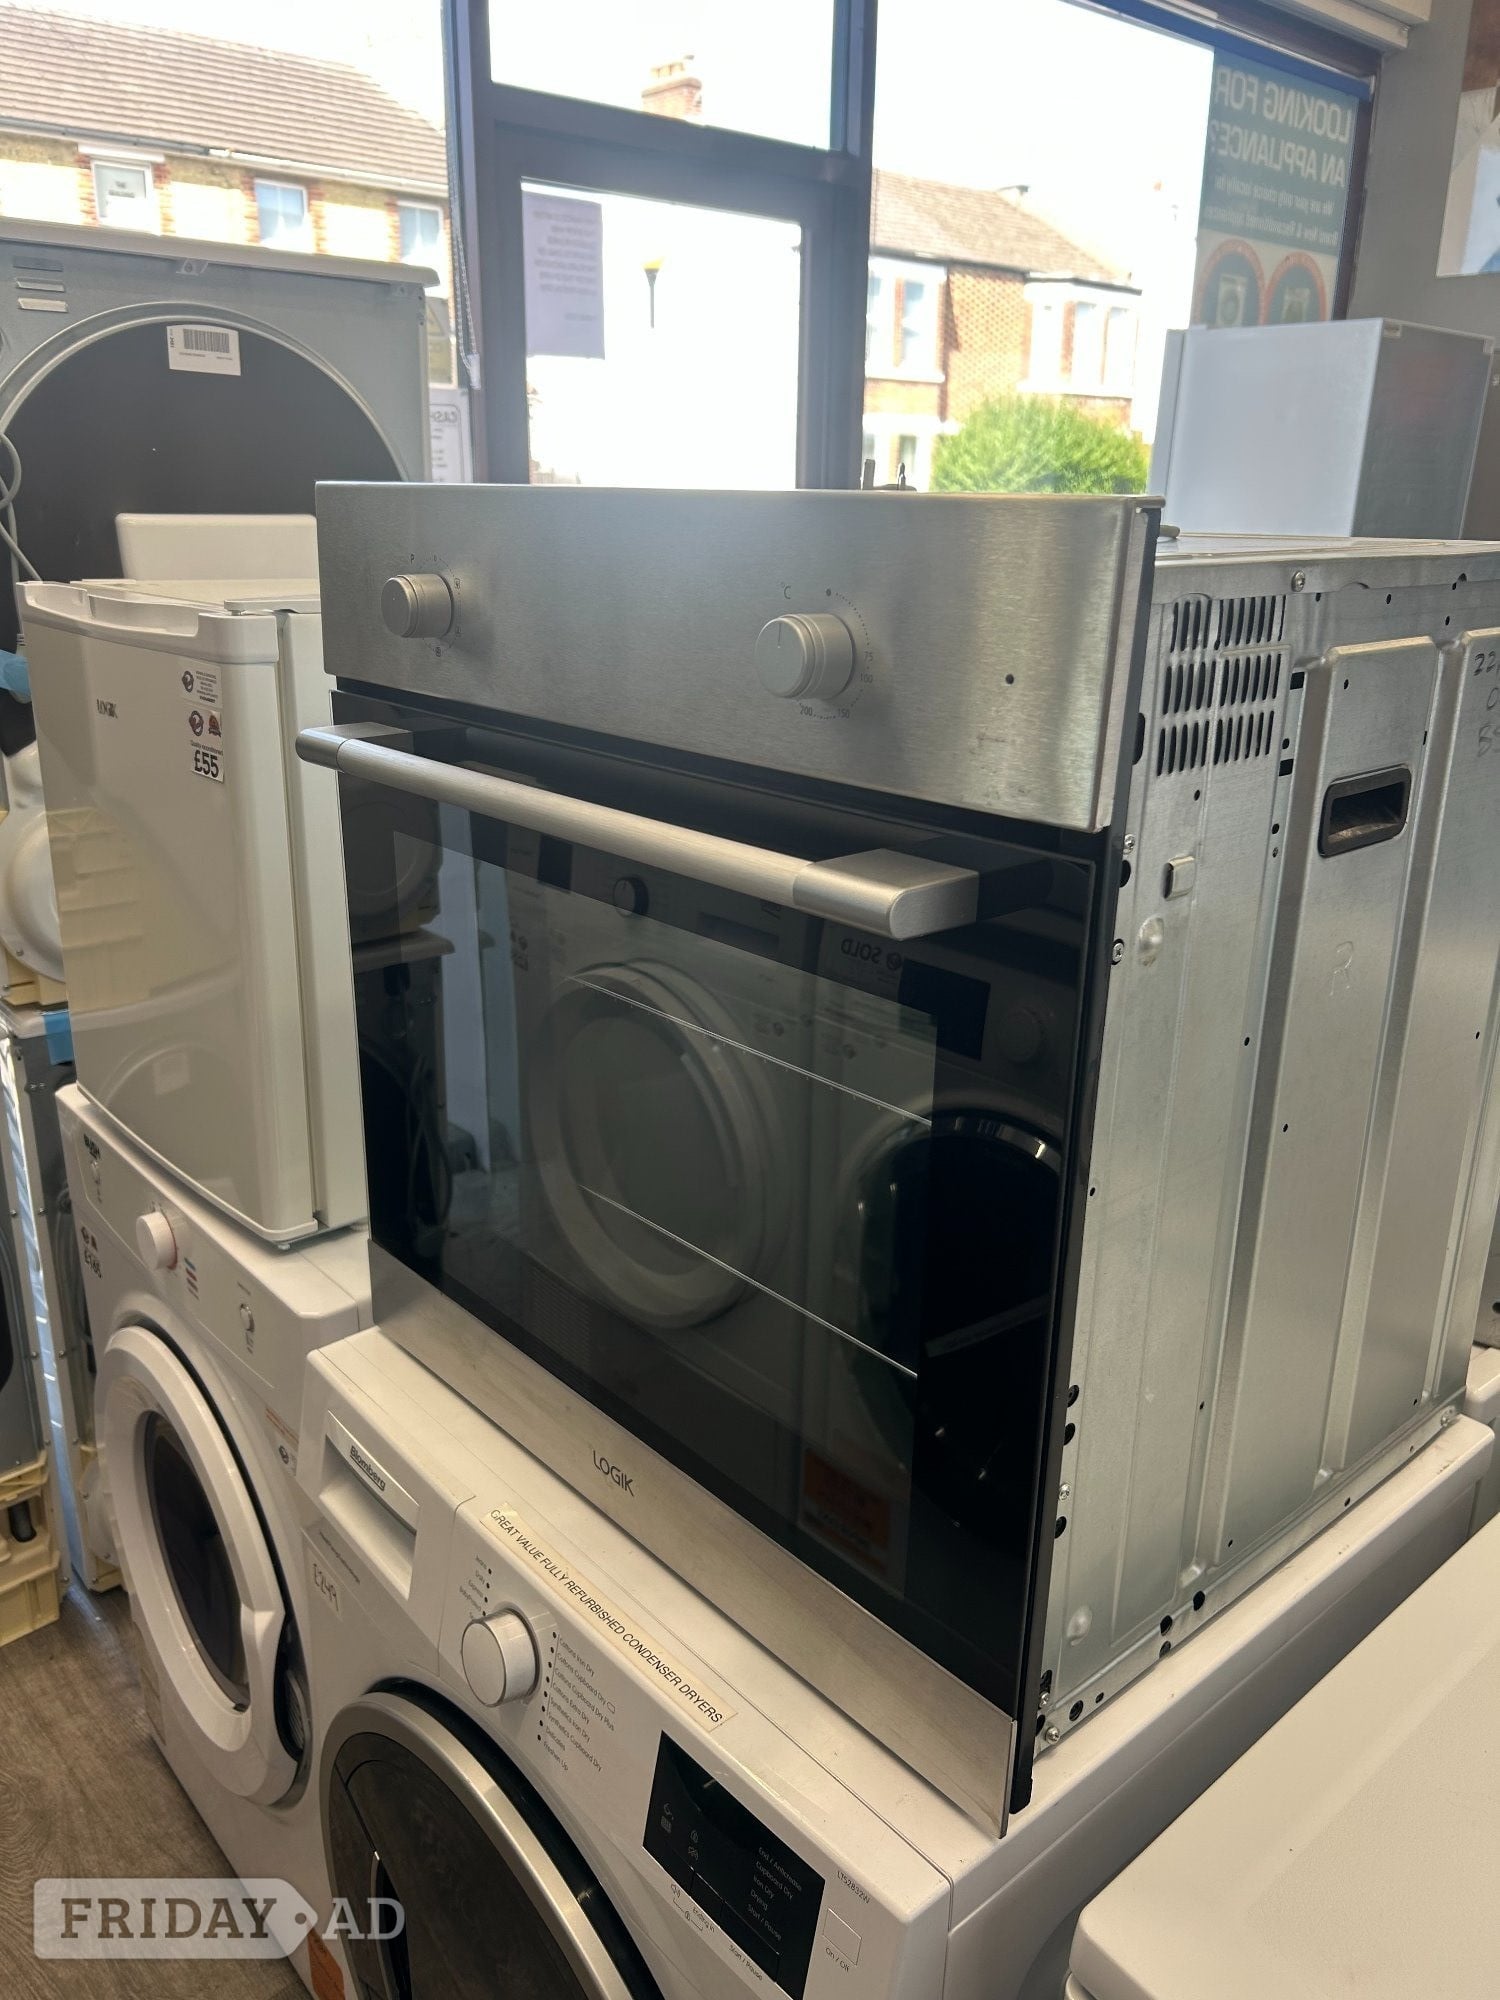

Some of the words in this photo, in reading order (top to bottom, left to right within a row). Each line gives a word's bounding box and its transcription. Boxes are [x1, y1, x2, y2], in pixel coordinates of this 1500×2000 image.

[800, 706, 813, 717] 200
[194, 750, 219, 778] £55
[350, 1445, 387, 1490] Blomberg
[593, 1450, 634, 1497] LOGIK
[490, 1508, 521, 1541] GREAT
[516, 1534, 544, 1561] VALUE
[540, 1556, 568, 1583] FULLY
[563, 1579, 626, 1636] REFURBISHED
[622, 1632, 682, 1687] CONDENSER
[679, 1683, 723, 1724] DRYERS
[586, 1663, 595, 1677] Dry
[581, 1711, 590, 1726] Dry
[594, 1708, 604, 1722] Dry
[581, 1729, 591, 1743] Dry
[592, 1758, 602, 1772] Dry
[825, 1947, 835, 1959] On
[839, 1960, 850, 1973] Off
